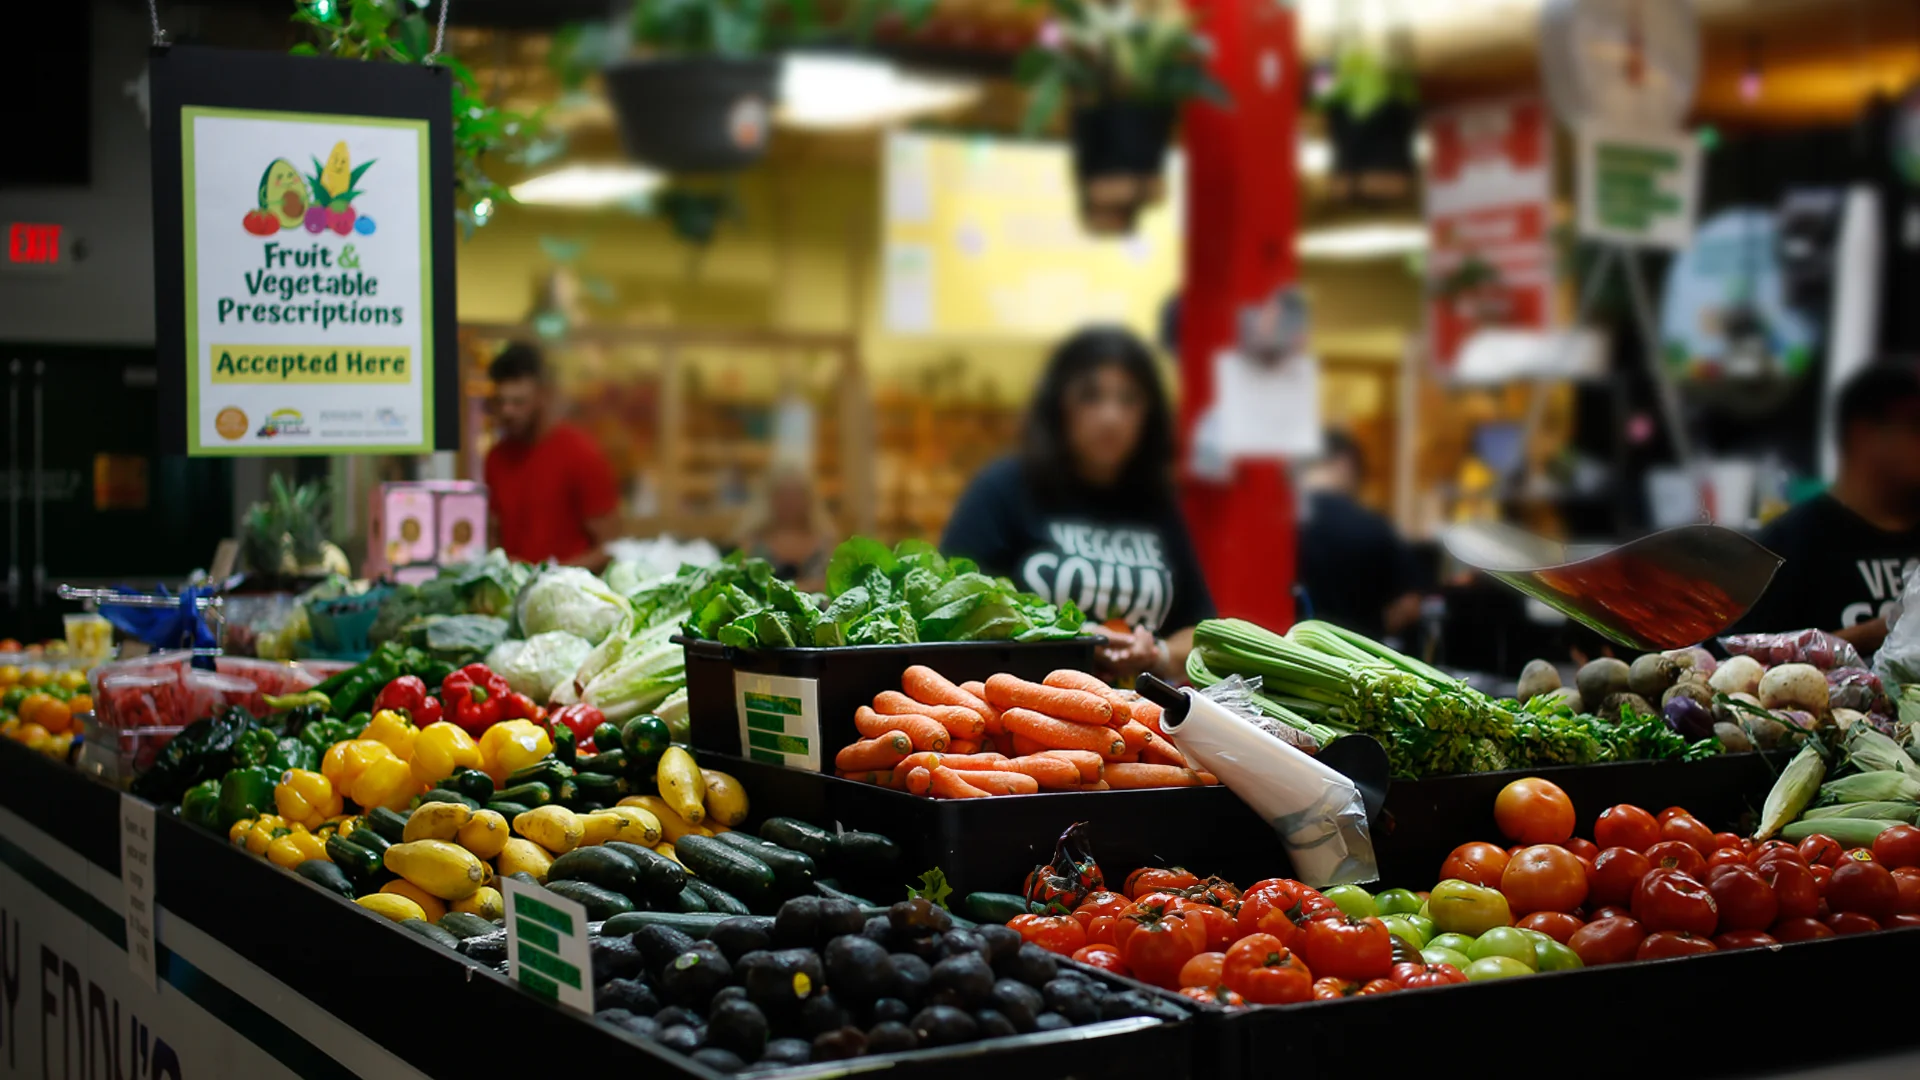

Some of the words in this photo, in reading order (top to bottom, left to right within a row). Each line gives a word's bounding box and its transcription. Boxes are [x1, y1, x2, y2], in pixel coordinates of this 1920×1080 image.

[10, 222, 62, 264] EXIT
[264, 242, 333, 269] Fruit
[337, 244, 361, 269] &
[245, 269, 378, 301] Vegetable
[218, 297, 404, 330] Prescriptions
[217, 351, 338, 379] Accepted
[346, 352, 406, 375] Here
[1050, 522, 1166, 570] VEGGIE
